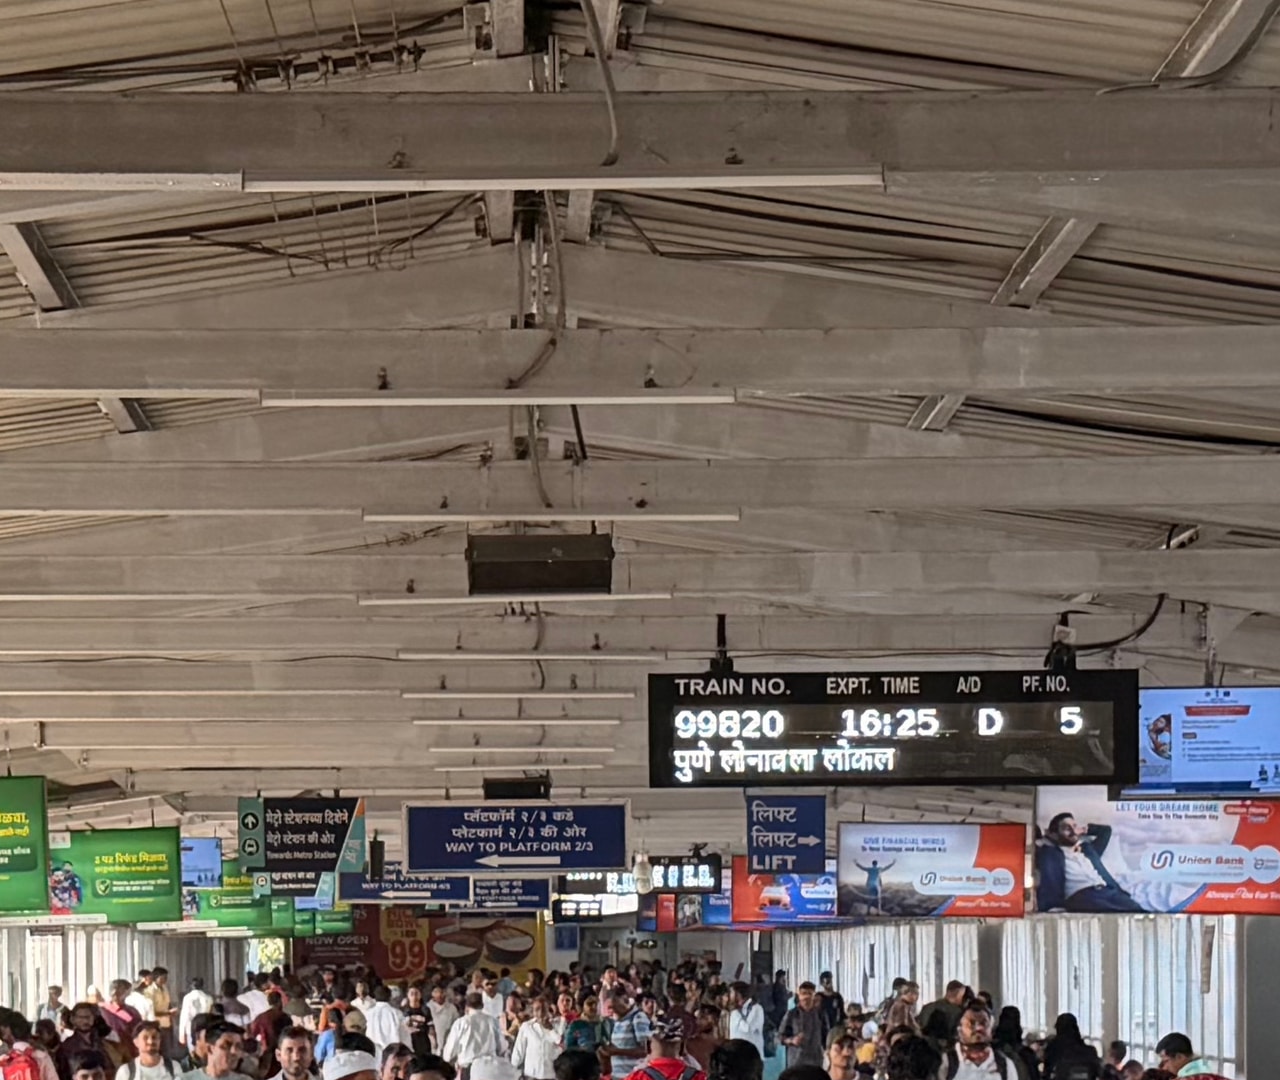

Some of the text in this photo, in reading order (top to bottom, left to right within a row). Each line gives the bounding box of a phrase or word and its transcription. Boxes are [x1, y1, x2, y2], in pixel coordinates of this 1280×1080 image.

[675, 677, 791, 696] TRAIN NO.
[827, 677, 920, 695] EXPT. TIME
[957, 676, 981, 694] A/D
[1023, 675, 1070, 693] PF. NO.
[675, 706, 1084, 738] 99820 16:25 D 5
[674, 740, 896, 782] पुणे लोनावला लोकल
[751, 800, 797, 823] लिफ्ट
[540, 824, 558, 838] की
[563, 823, 587, 838] ओर
[751, 825, 797, 848] लिफ्ट
[445, 841, 594, 852] WAY TO PLATFORM 2/3
[753, 855, 797, 870] LIFT
[1178, 855, 1212, 865] Union
[1215, 855, 1244, 865] Bank
